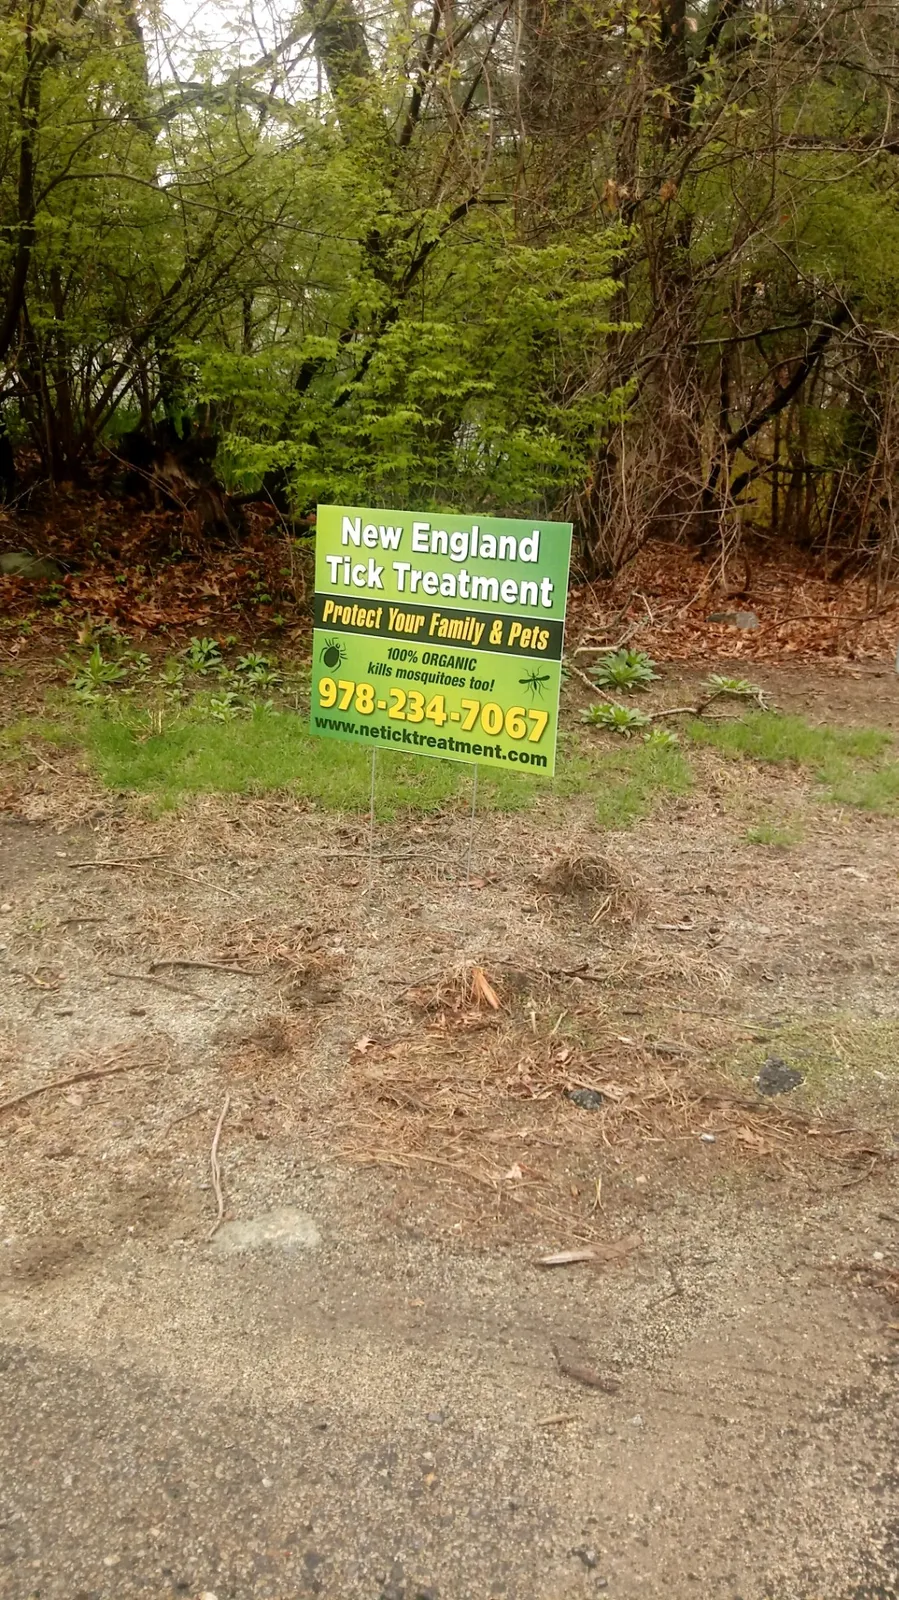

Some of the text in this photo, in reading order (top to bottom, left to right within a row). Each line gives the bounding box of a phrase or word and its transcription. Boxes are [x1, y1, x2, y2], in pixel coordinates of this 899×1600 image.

[341, 517, 540, 562] New England
[326, 555, 554, 607] Tick Treatment
[323, 600, 550, 650] Protect Your Family & Pets
[368, 662, 495, 692] kills mosquitoes too!
[388, 648, 477, 671] 100% ORGANIC
[318, 677, 549, 742] 978-234-7067
[315, 716, 547, 767] www.neticktreatment.com
